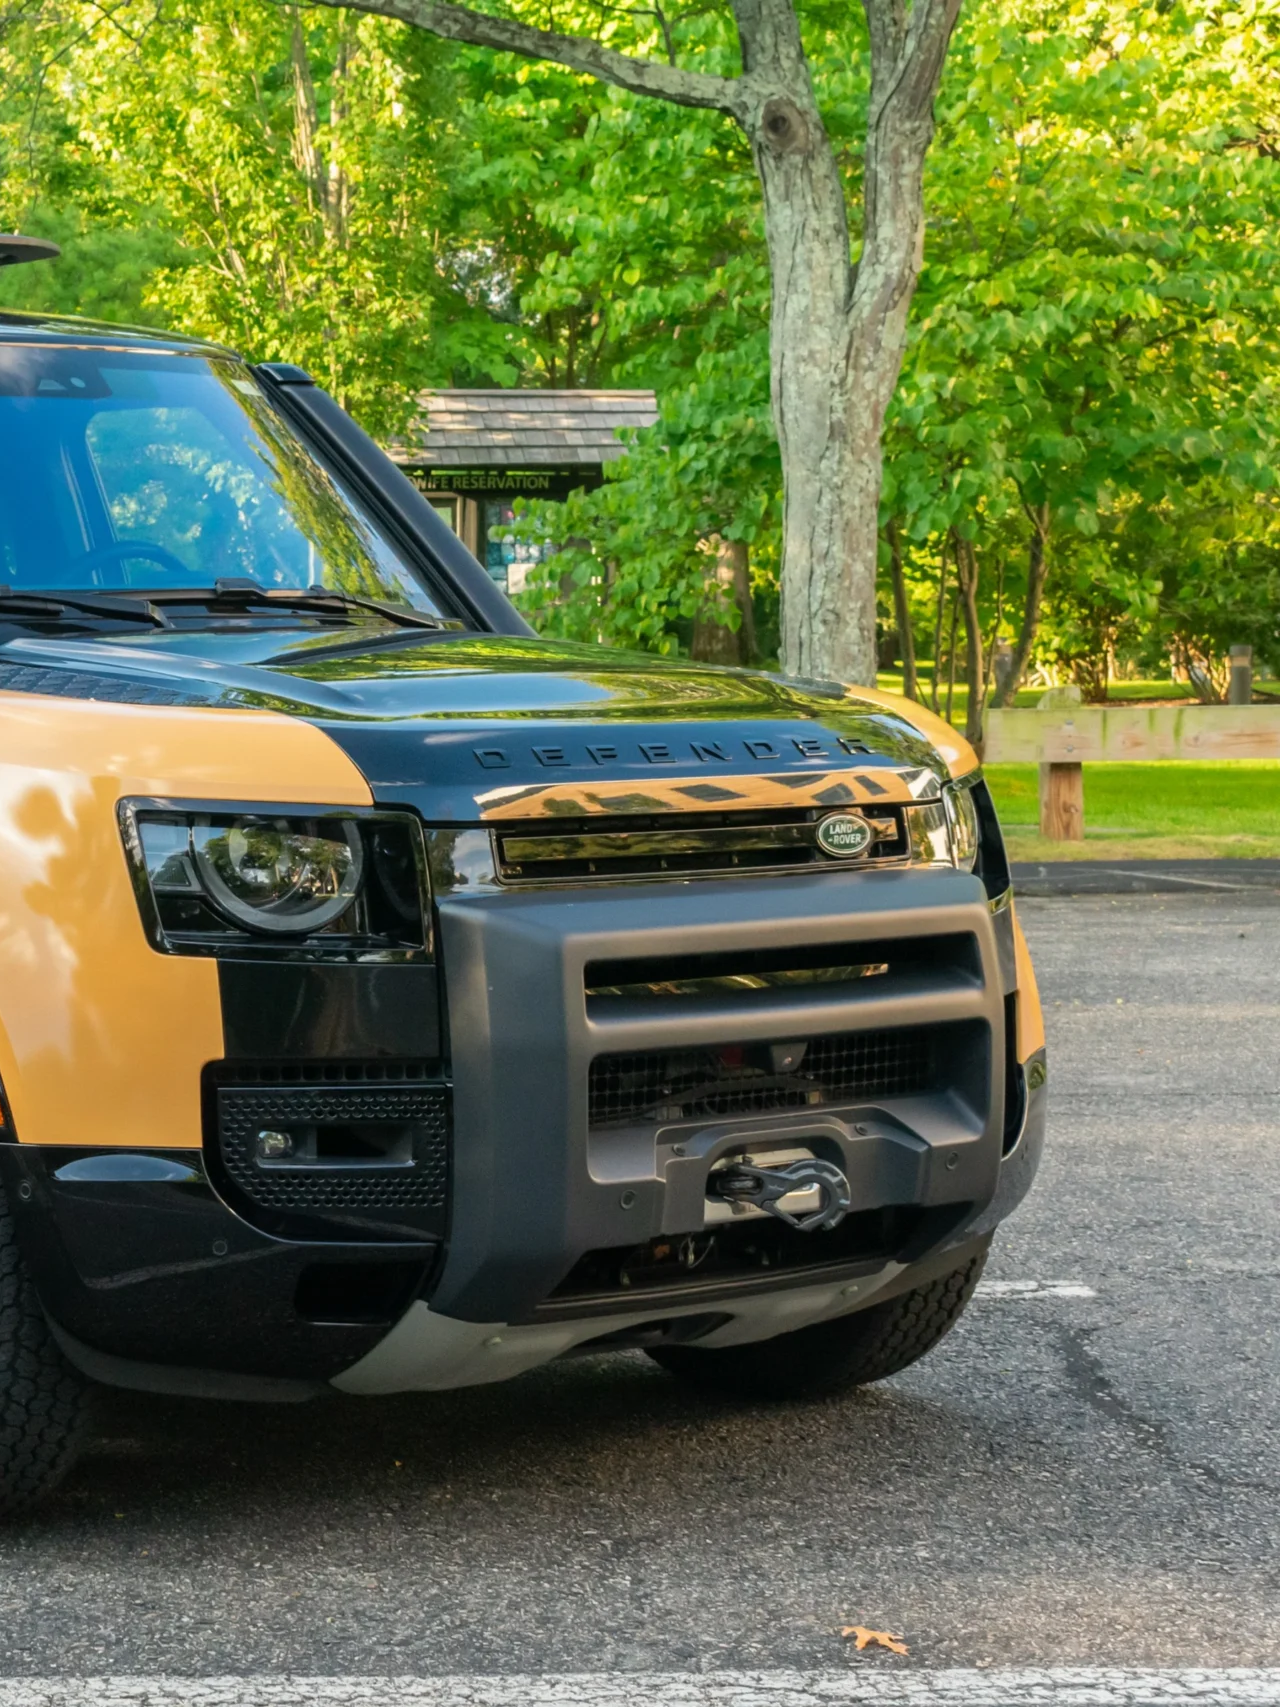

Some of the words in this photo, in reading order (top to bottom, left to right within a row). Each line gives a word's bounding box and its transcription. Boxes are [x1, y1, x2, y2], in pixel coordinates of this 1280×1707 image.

[452, 475, 549, 490] RESERVATION
[472, 737, 876, 769] DEFENDER
[829, 823, 853, 835] LAND
[833, 833, 862, 845] ROVER
